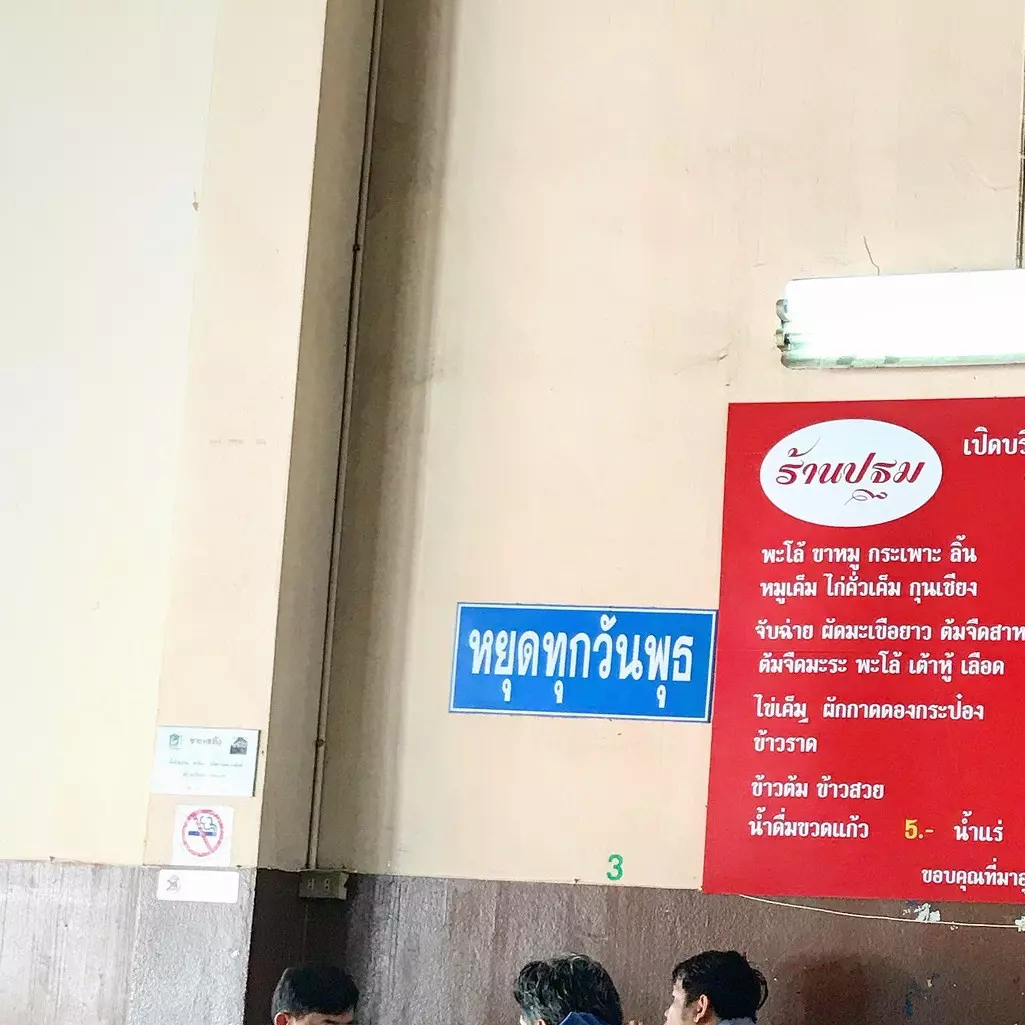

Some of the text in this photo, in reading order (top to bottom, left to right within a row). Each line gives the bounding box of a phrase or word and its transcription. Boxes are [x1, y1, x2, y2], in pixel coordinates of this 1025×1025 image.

[775, 436, 926, 506] ร้านปฐม
[761, 535, 977, 573] พะโล้ ขาหมู กระเพาะ ลิ้น
[760, 574, 817, 604] หมูเค็ม
[824, 569, 901, 596] ไก่คั่วเค็ม
[910, 573, 977, 603] กุนเชียง
[755, 618, 813, 639] จับฉ่าย
[822, 618, 931, 640] ผัดมะเขือยาว
[468, 613, 694, 709] หยุดทุกวันพุธ
[759, 652, 847, 673] ต้มจืดมะระ
[856, 651, 902, 674] พะโล้
[909, 652, 954, 682] เต้าหู้
[961, 652, 1004, 675] เลือด
[753, 694, 809, 721] ไข่เค็ม
[823, 694, 984, 719] ผักกาดดองกระป๋อง
[753, 729, 817, 752] ข้าวราด
[751, 774, 808, 797] ข้าวต้ม
[816, 775, 884, 799] ข้าวสวย
[748, 807, 868, 838] น้ำดื่มขวดแก้ว
[954, 811, 1003, 841] น้ำแร่
[606, 854, 623, 881] 3
